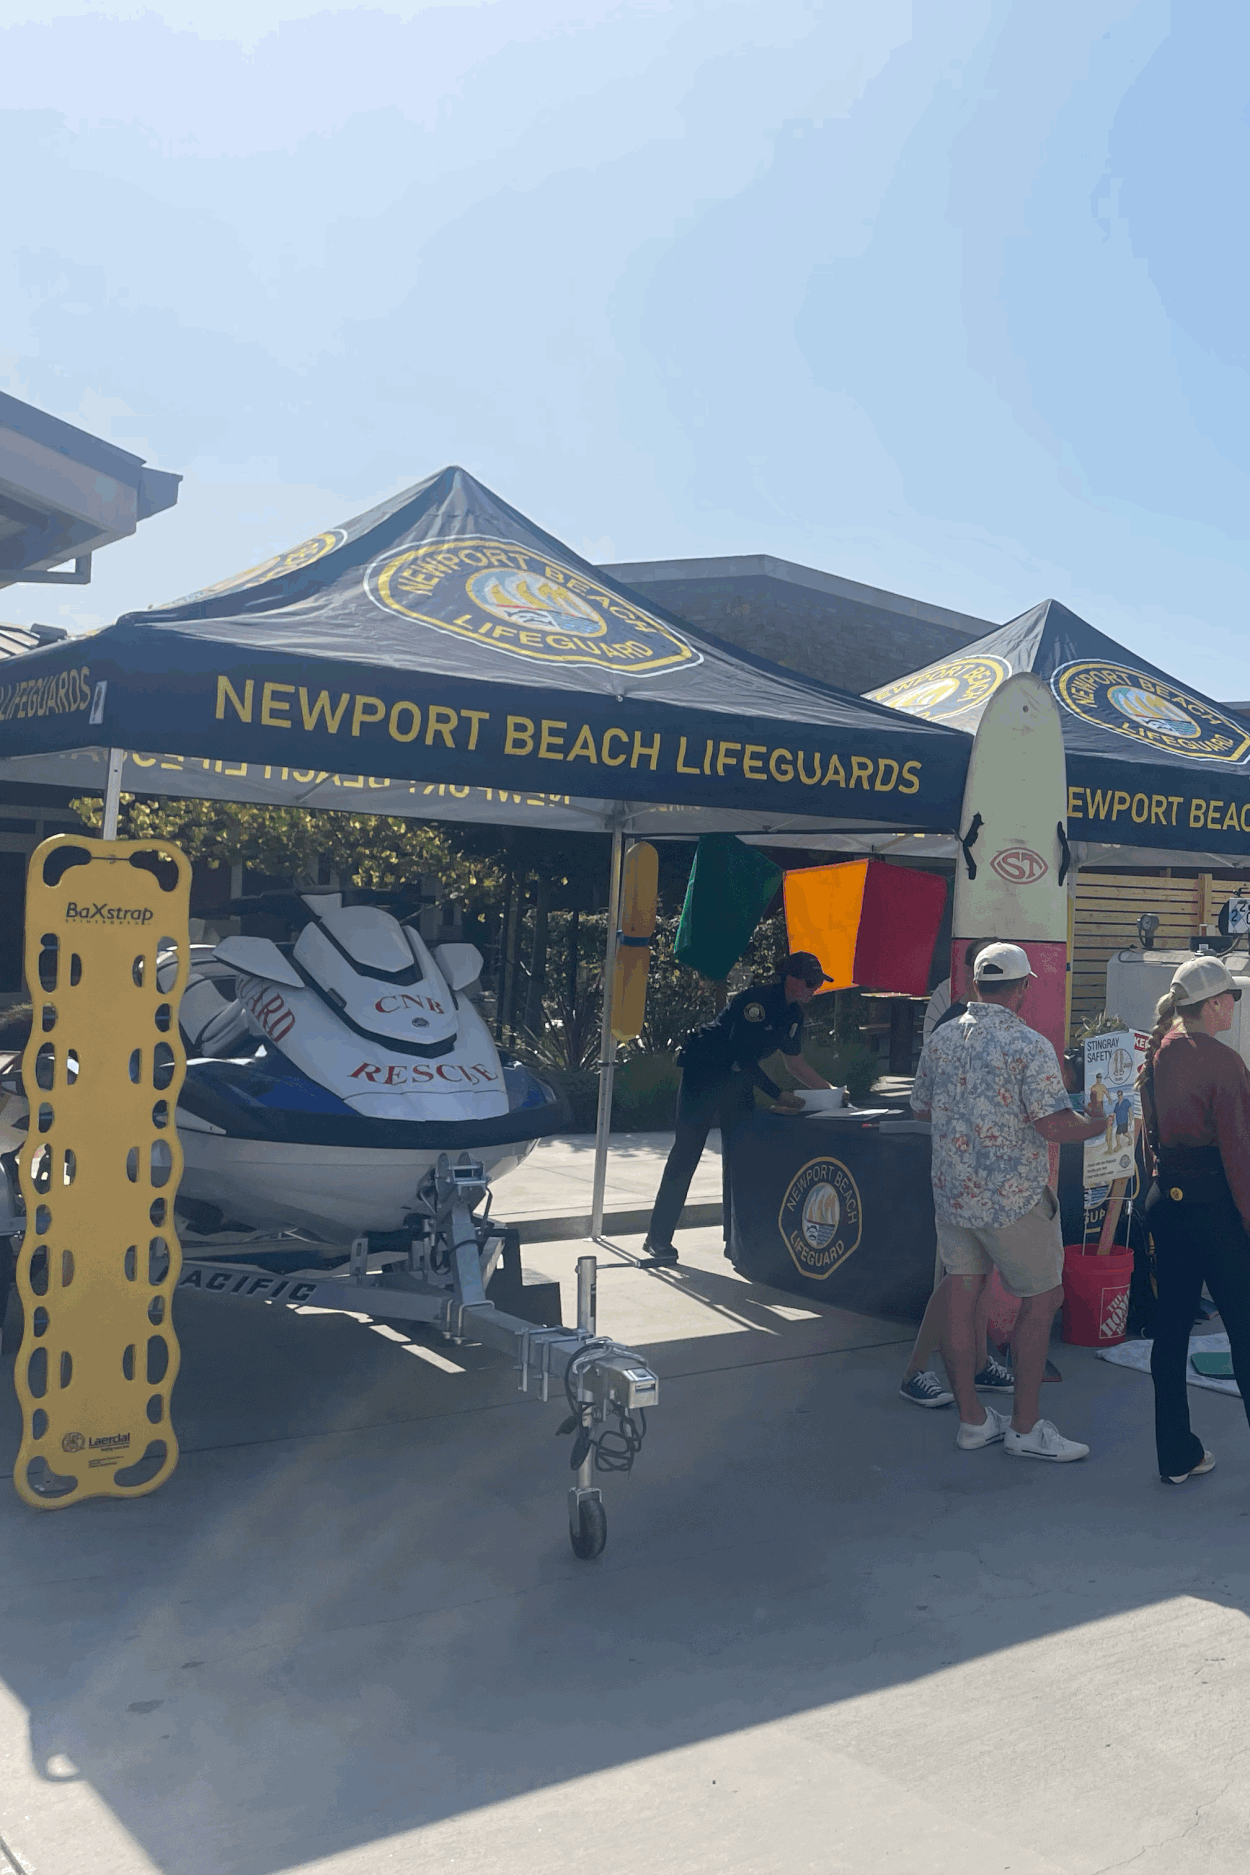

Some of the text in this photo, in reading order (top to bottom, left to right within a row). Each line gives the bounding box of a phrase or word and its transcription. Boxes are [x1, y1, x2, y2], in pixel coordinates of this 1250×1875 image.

[397, 548, 659, 634] NEWPORT BEACH
[453, 613, 654, 660] LIFEGUARD
[874, 664, 975, 701] EWPORT
[1070, 670, 1223, 725] NEWPORT BEACH
[214, 674, 923, 795] NEWPORT BEACH LIFEGUARDS
[1122, 722, 1234, 752] LIFEGUARD
[1066, 786, 1184, 826] EWPORT
[66, 902, 154, 925] BaXstrap
[1231, 909, 1238, 921] 2
[374, 994, 445, 1015] CNB
[1086, 1037, 1120, 1052] STINGRAY
[1087, 1050, 1113, 1063] SAFETY
[786, 1164, 858, 1225] NEWPORT BEACH
[790, 1230, 845, 1267] LIFEGUARD
[155, 1265, 317, 1302] ACIFIC
[88, 1432, 131, 1446] Laerdal
